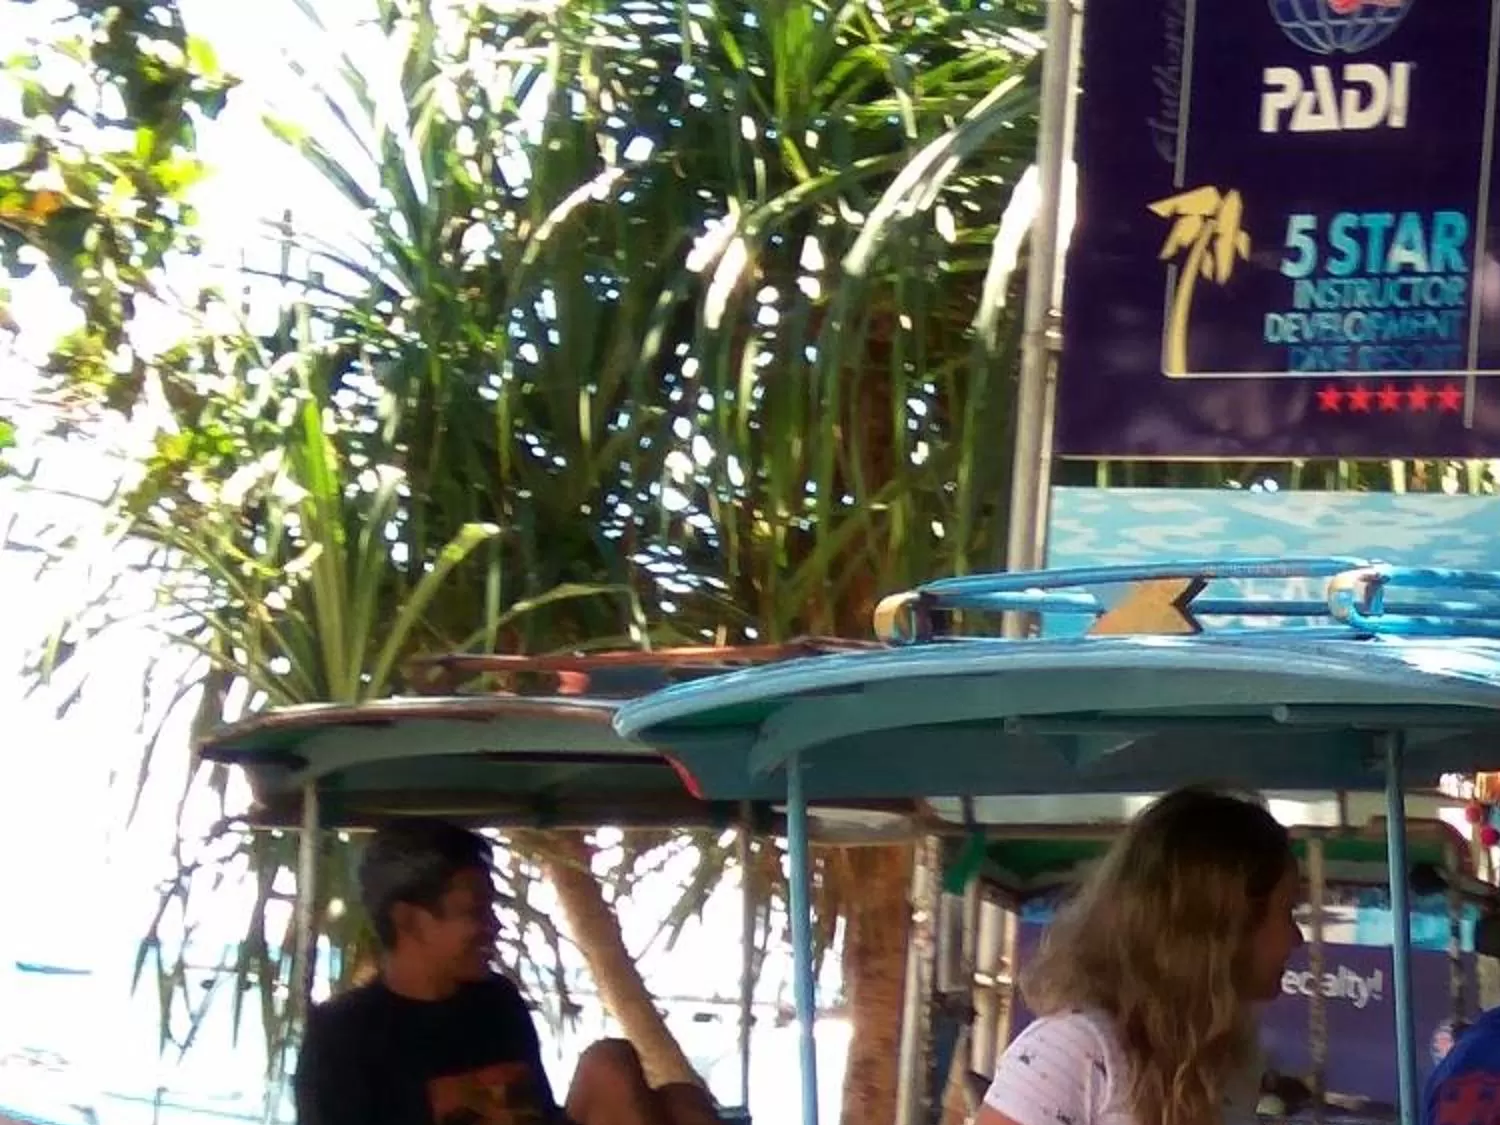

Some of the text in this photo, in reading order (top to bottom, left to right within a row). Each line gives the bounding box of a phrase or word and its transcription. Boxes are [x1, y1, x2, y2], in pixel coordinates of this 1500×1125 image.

[1259, 61, 1411, 132] PADI
[1279, 211, 1469, 278] 5 STAR
[1293, 275, 1467, 309] INSTRUCTOR
